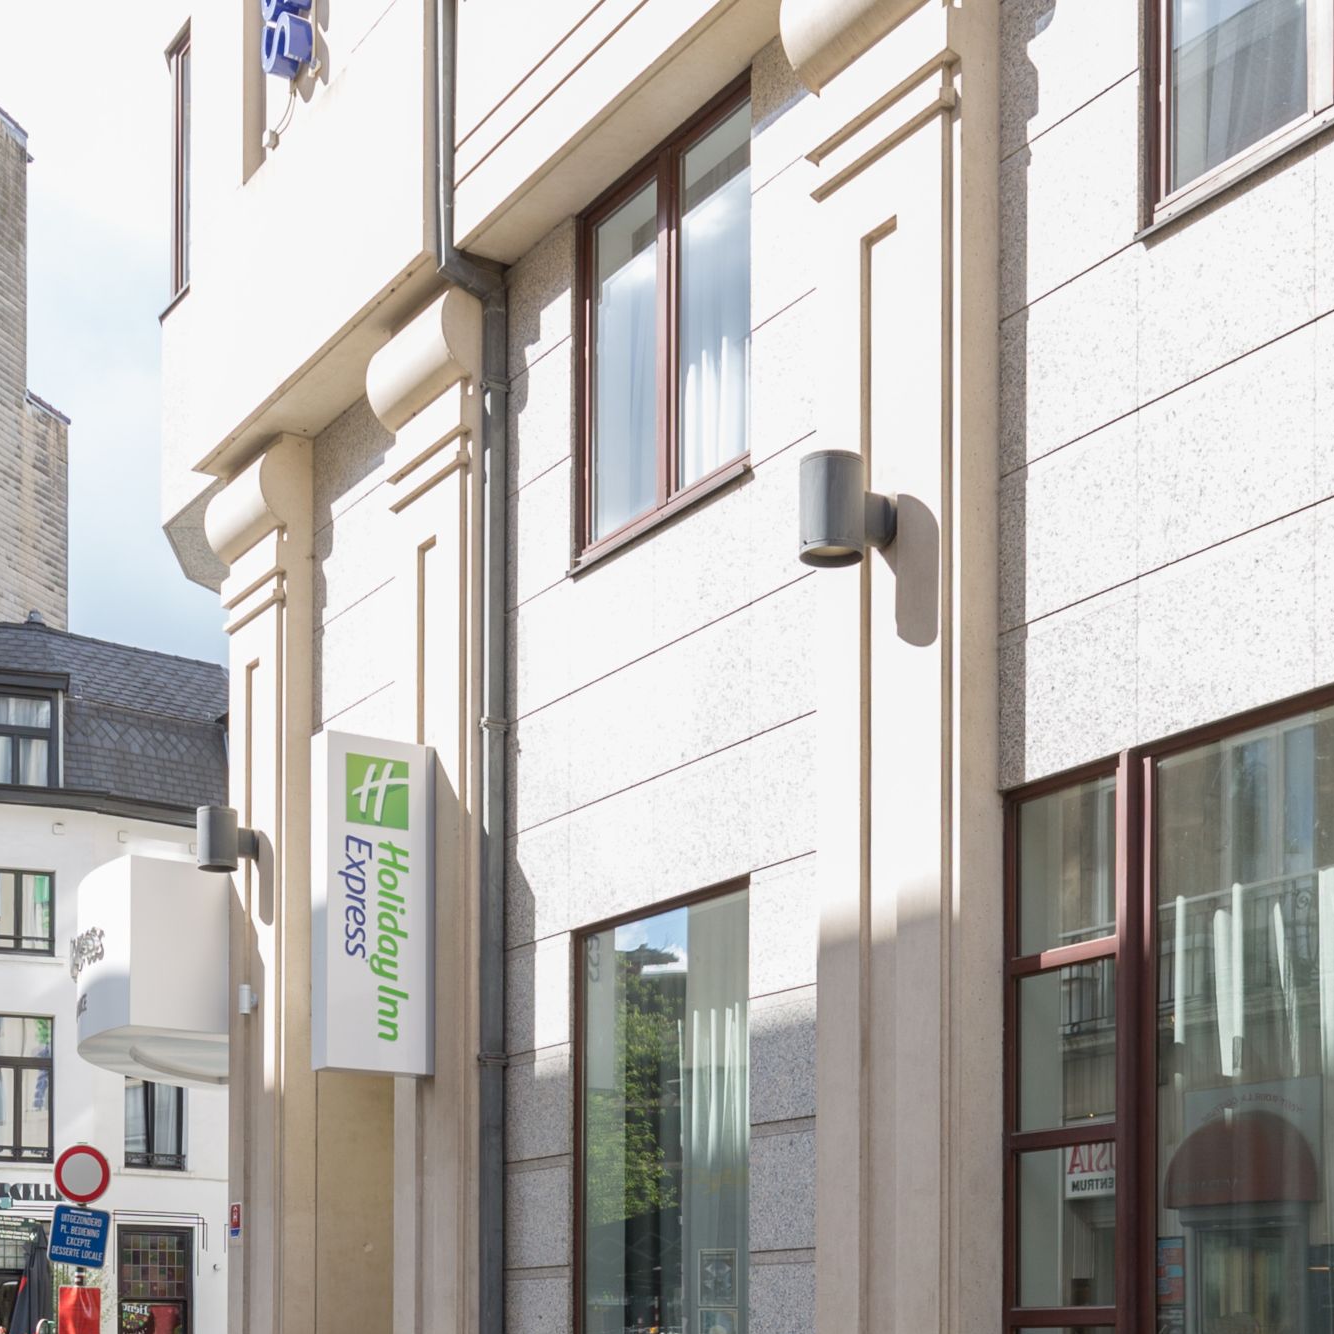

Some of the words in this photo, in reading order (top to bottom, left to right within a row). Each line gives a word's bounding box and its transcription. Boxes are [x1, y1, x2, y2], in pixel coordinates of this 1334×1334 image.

[338, 835, 372, 959] Express
[370, 841, 409, 981] Holiday
[378, 985, 409, 1042] Inn
[61, 1213, 103, 1228] UITGEZONDERD
[60, 1224, 70, 1234] PL.
[70, 1226, 100, 1239] BEDIENING
[66, 1236, 91, 1248] EXCEPTE
[51, 1245, 80, 1258] DESSERTE
[81, 1249, 103, 1261] LOCALE
